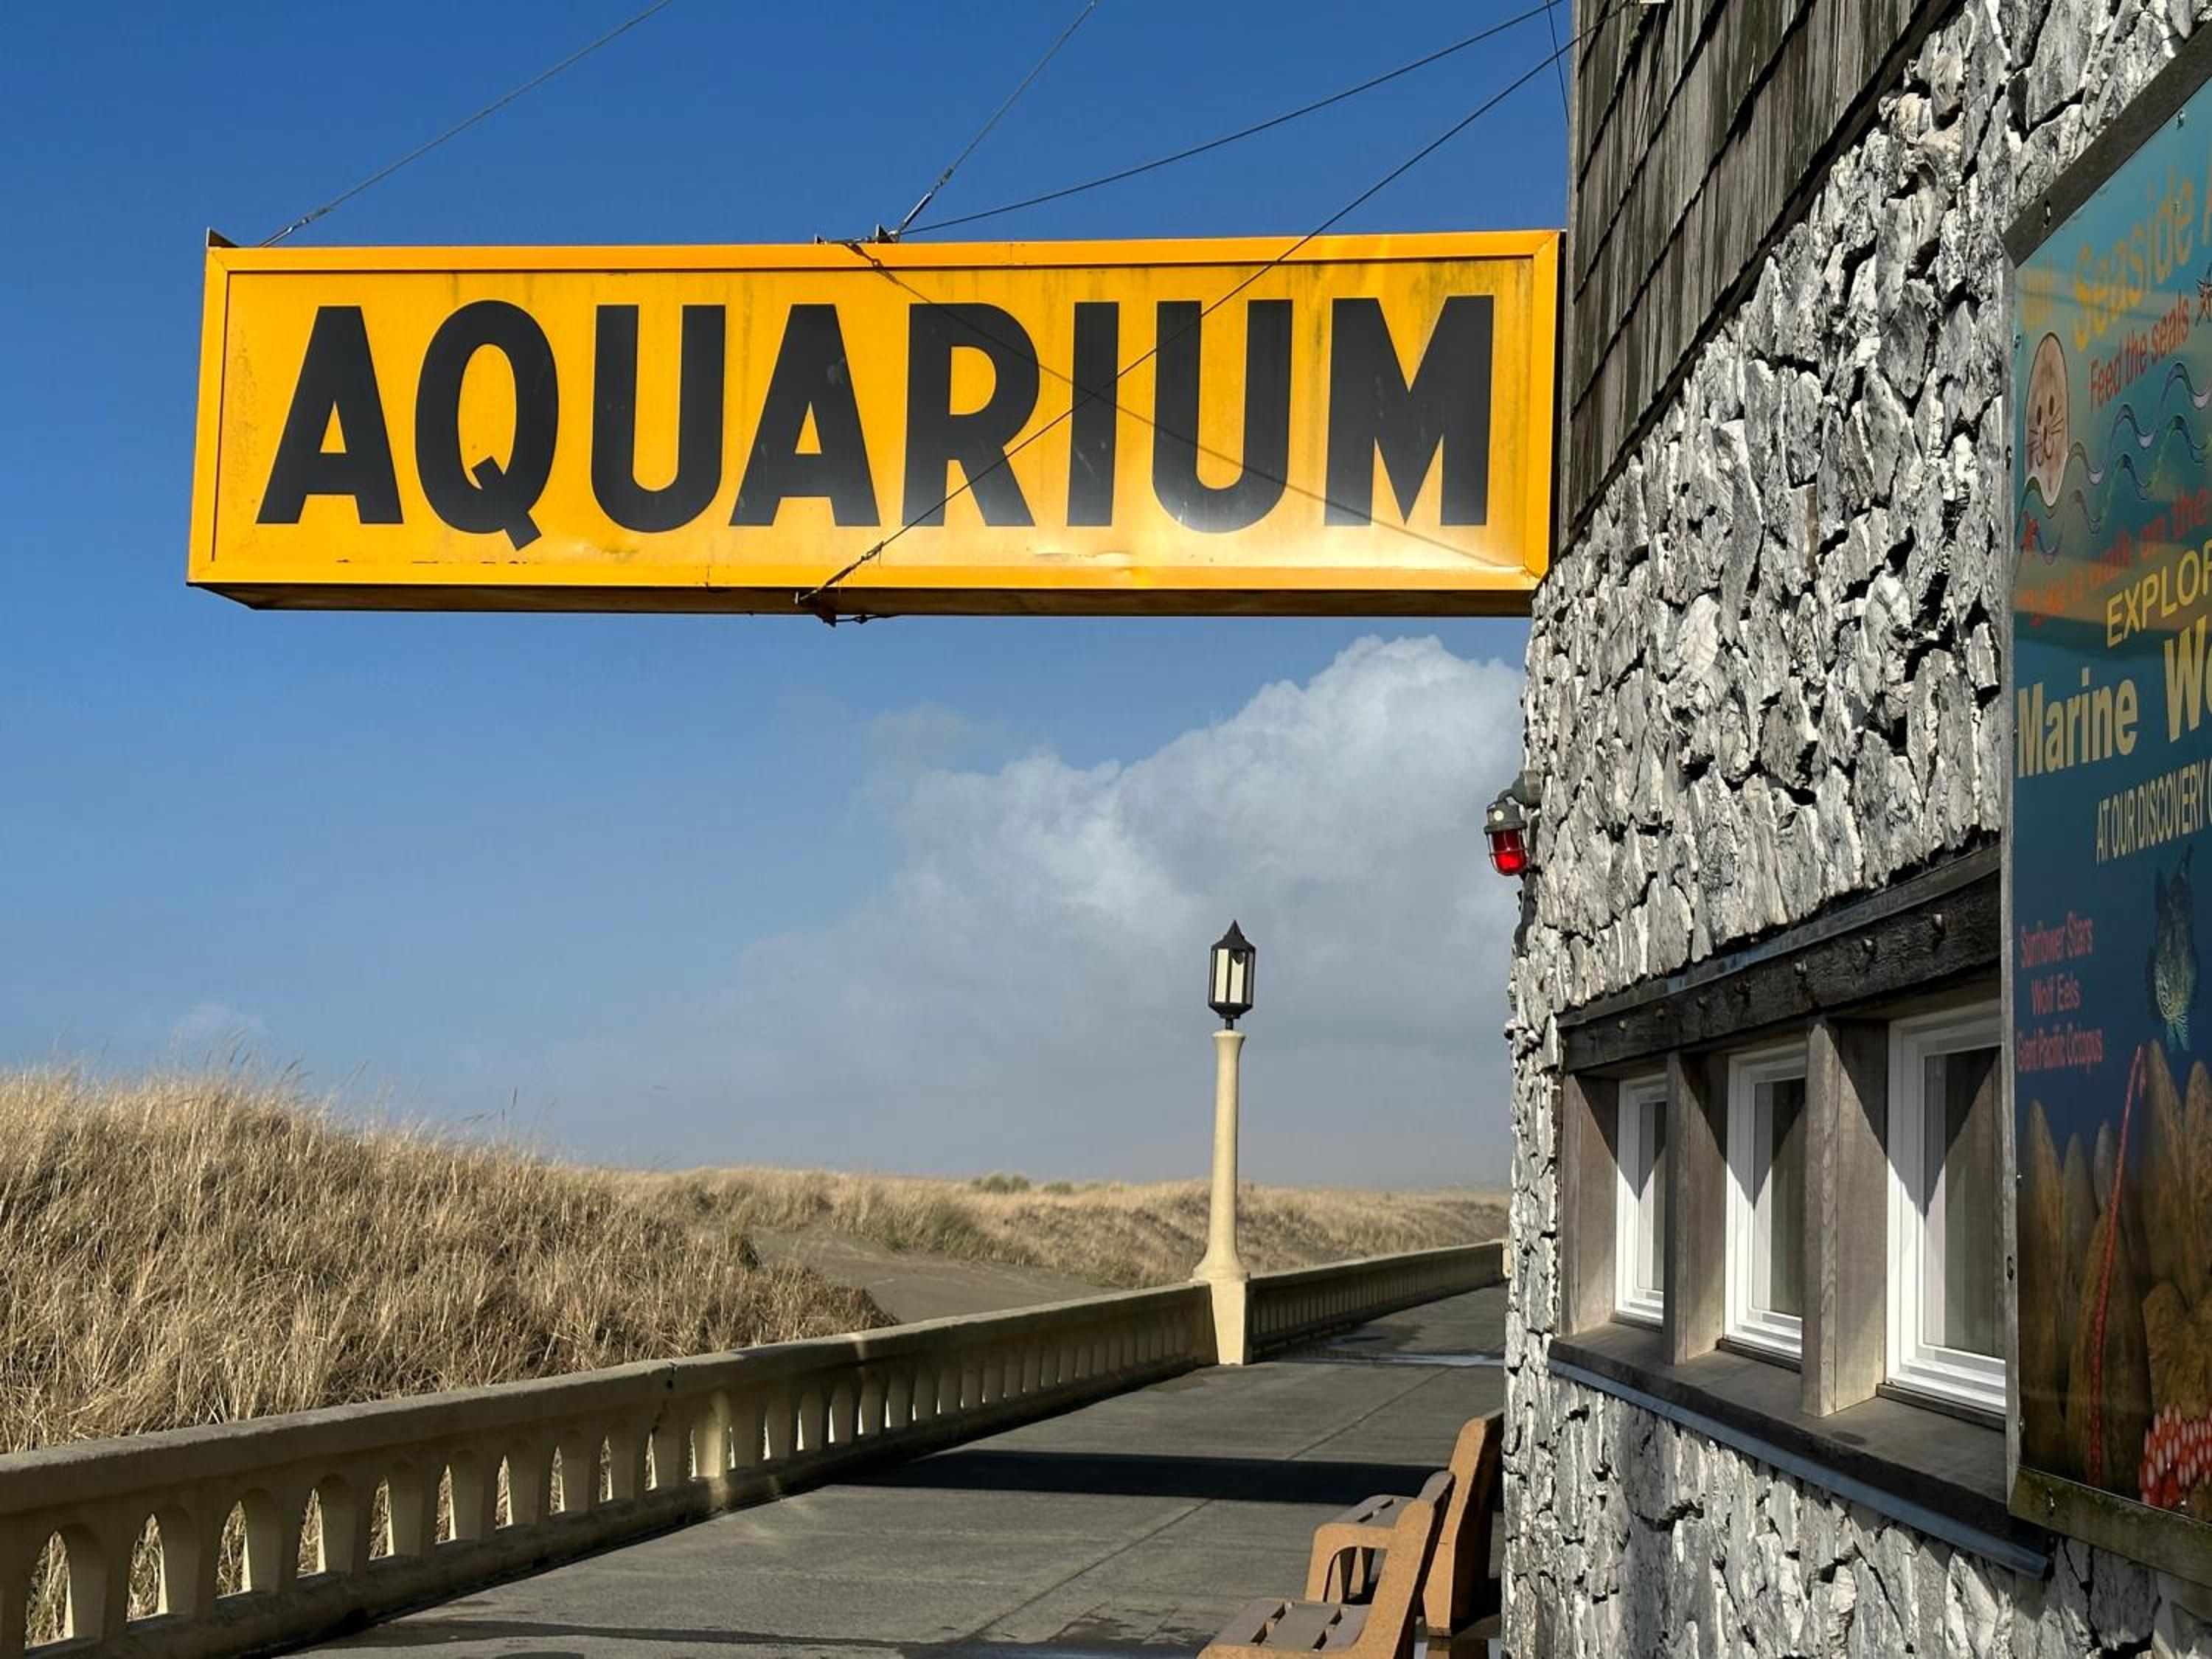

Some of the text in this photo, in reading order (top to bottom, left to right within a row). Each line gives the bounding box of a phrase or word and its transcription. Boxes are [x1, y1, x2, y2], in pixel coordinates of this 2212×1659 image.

[2073, 167, 2195, 352] Seaside
[2088, 290, 2190, 411] Feed the seals
[257, 295, 1495, 552] AQUARIUM
[2171, 487, 2210, 540] the
[2017, 667, 2138, 779] Marine
[2096, 796, 2110, 867] AT
[2111, 787, 2136, 860] OUR
[2137, 758, 2207, 850] DISCOVERY
